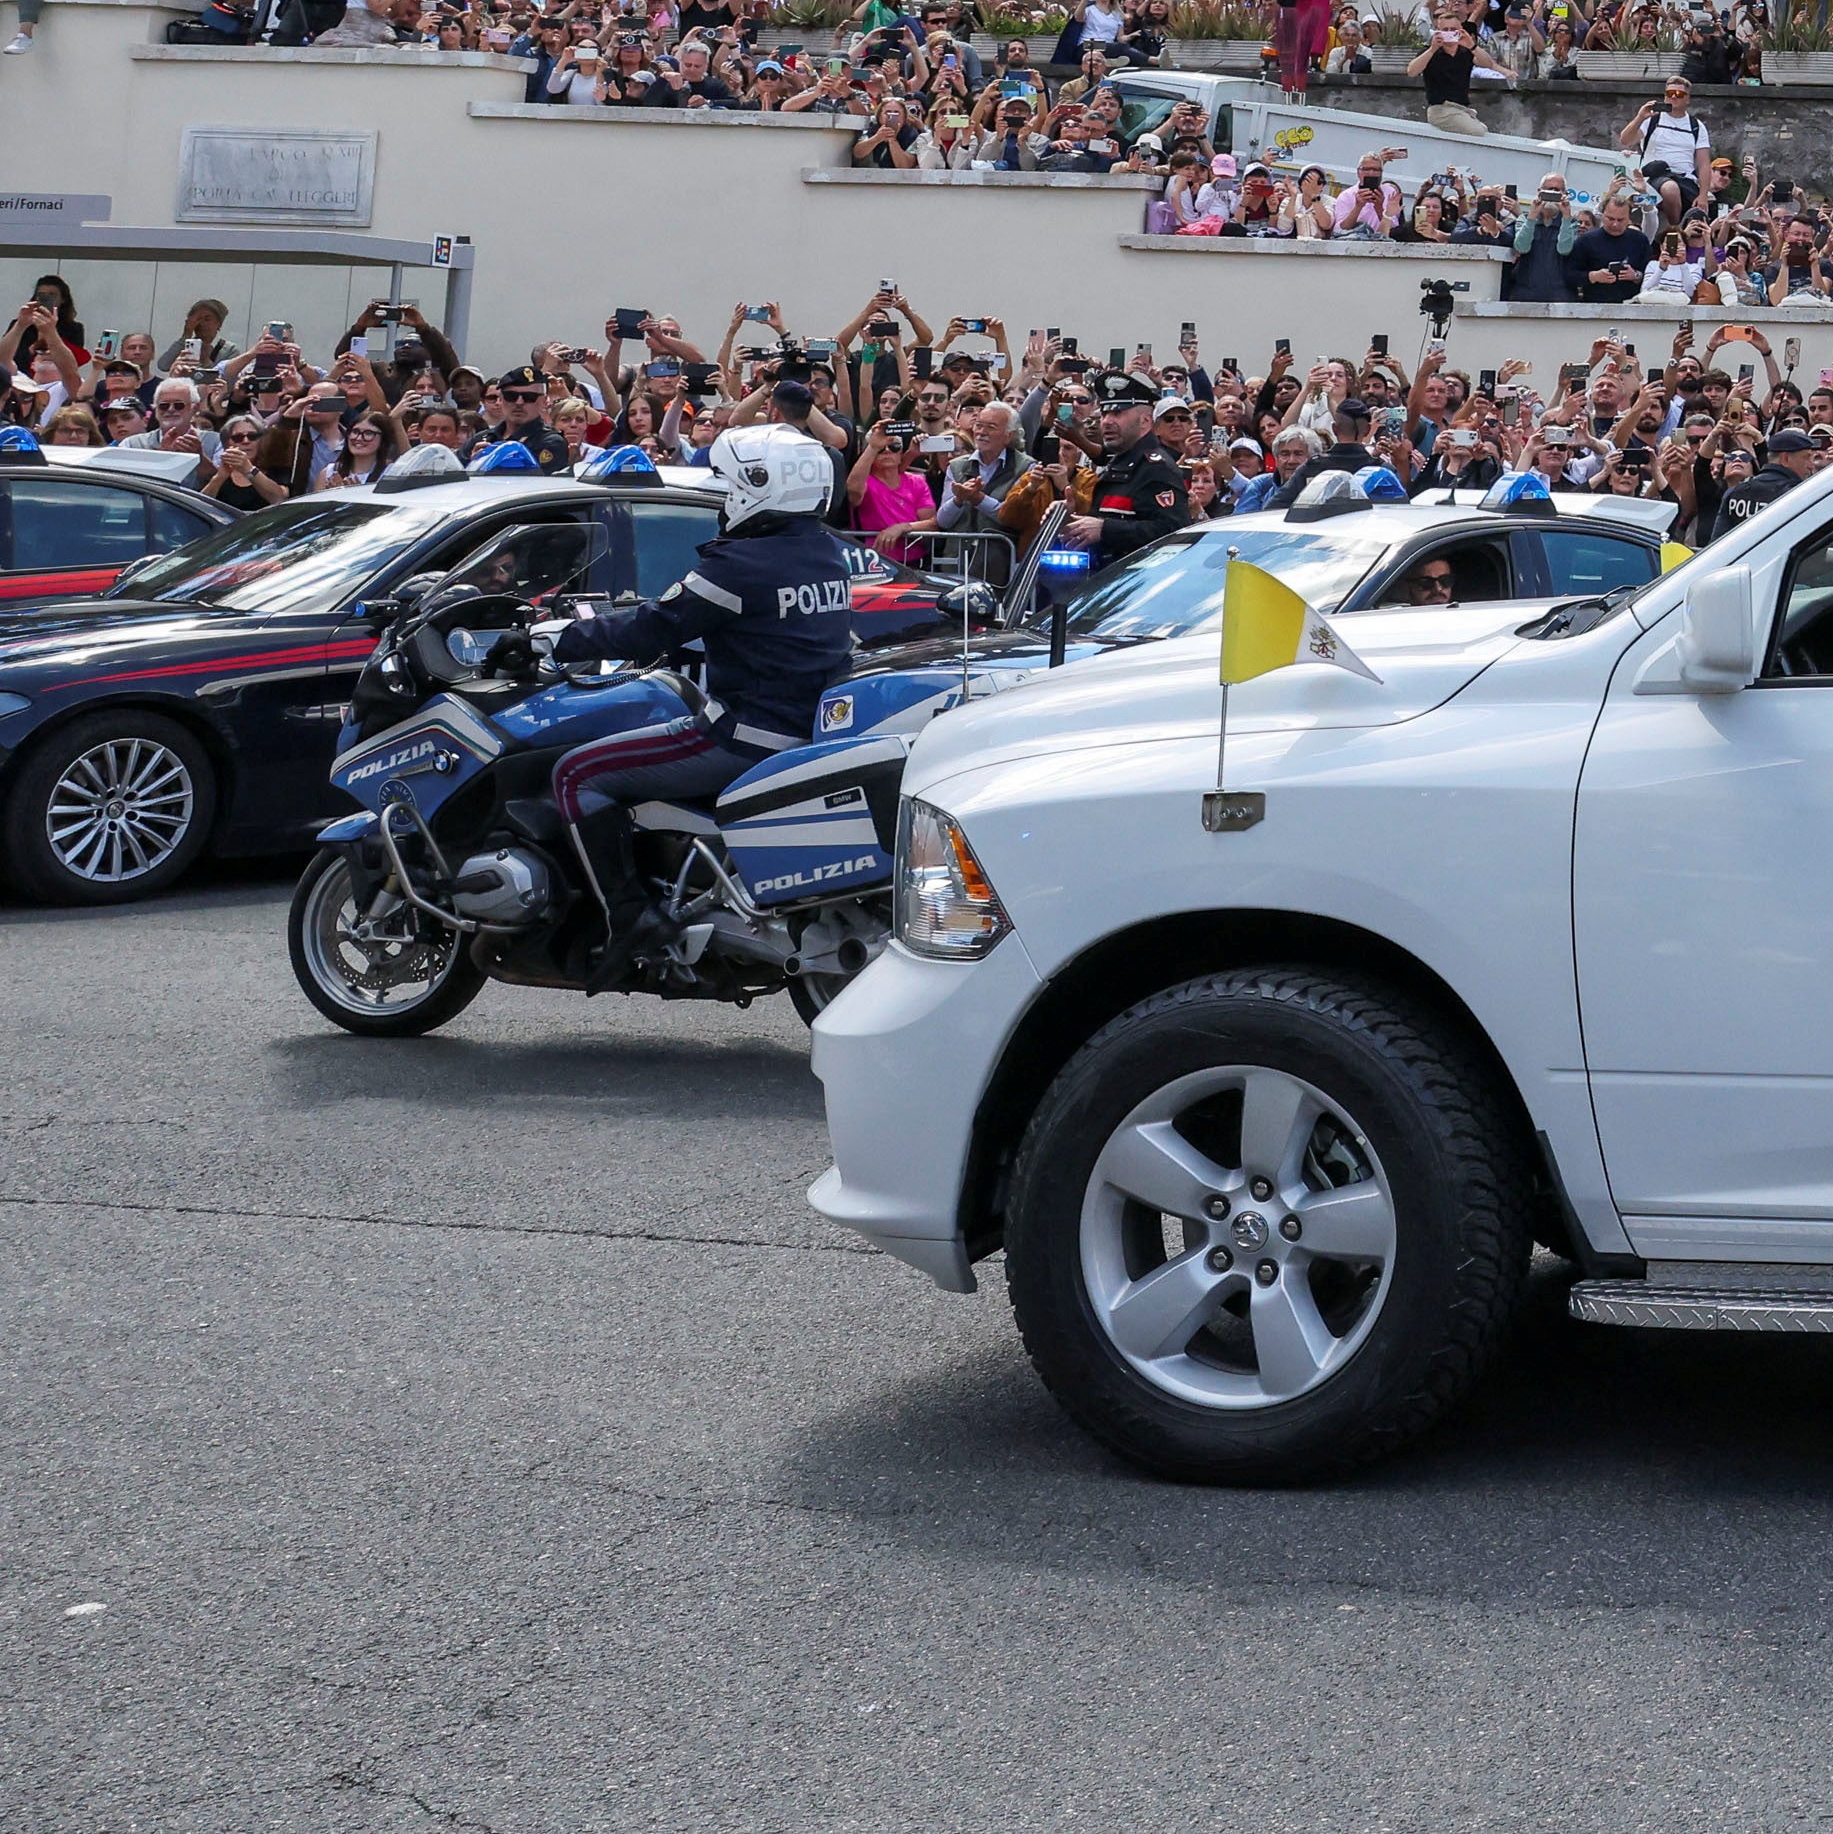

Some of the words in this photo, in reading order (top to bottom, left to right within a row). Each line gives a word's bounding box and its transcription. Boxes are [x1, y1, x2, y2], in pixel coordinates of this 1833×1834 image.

[250, 187, 357, 205] CAVLLEGGERI
[1728, 498, 1769, 518] POLI
[842, 548, 883, 574] 112
[346, 740, 436, 786] POLIZIA
[832, 794, 852, 805] BMW
[754, 854, 877, 896] POLIZIA
